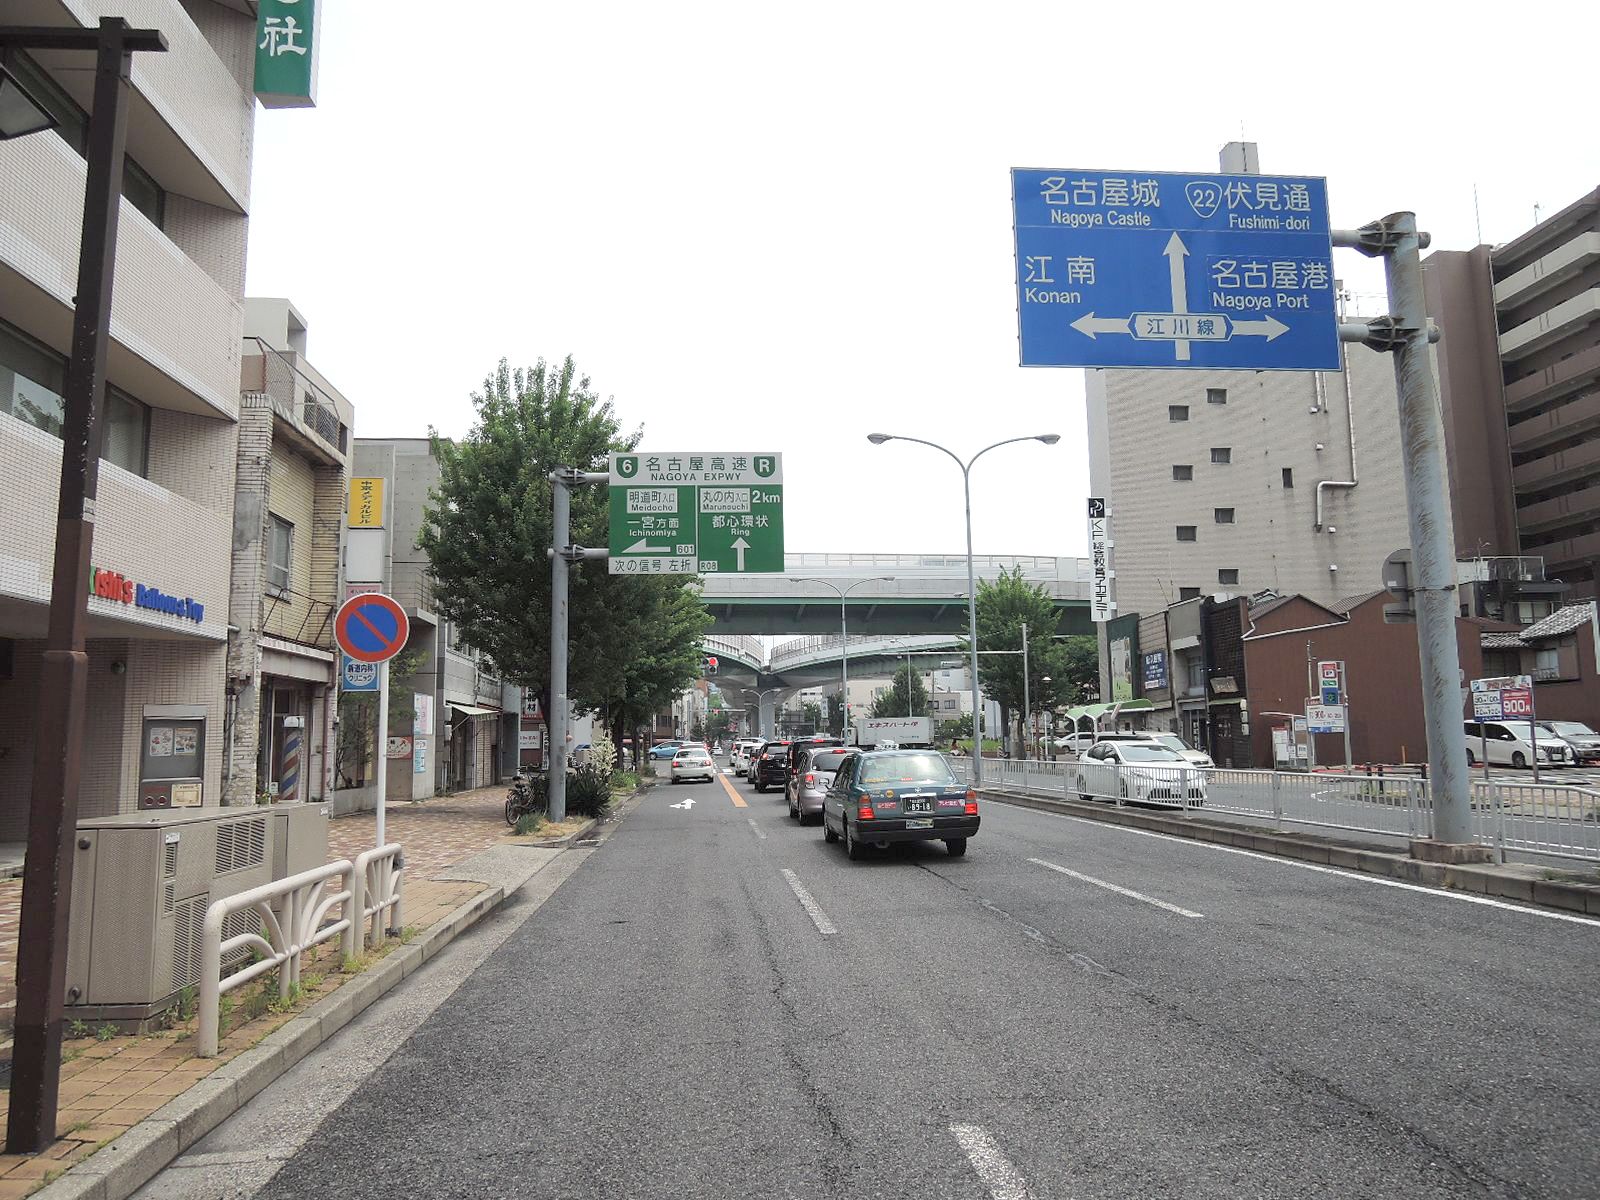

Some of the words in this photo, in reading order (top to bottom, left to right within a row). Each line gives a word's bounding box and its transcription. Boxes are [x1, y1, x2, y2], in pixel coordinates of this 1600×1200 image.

[260, 0, 307, 57] 社
[1039, 176, 1160, 208] 名古屋城
[1193, 190, 1216, 207] 22
[1223, 181, 1312, 212] 伏見通
[1051, 209, 1102, 229] Nagoya
[1107, 211, 1151, 227] Castle
[1229, 213, 1310, 231] Fushimi-dori
[1024, 255, 1096, 286] 江南
[1212, 259, 1329, 290] 名古屋港
[1025, 287, 1081, 304] Konan
[1213, 293, 1272, 310] Nagoya
[1276, 294, 1310, 308] Port
[1147, 318, 1215, 336] 江川線
[622, 459, 633, 473] 6
[645, 456, 747, 472] 名古屋高速
[759, 458, 771, 473] R
[651, 473, 696, 481] NAGOYA
[704, 473, 741, 481] EXPWY
[629, 490, 675, 504] 明道町入口
[703, 490, 749, 503] 丸の内入口
[702, 503, 749, 511] Marunouchi
[627, 516, 679, 529] 一宮方面
[712, 515, 769, 528] 都心環状
[629, 529, 677, 538] Ichinomiya
[731, 528, 750, 537] Ring
[677, 545, 694, 554] 601
[615, 559, 661, 572] 次の信号
[668, 559, 691, 572] 左折
[701, 562, 717, 571] R08
